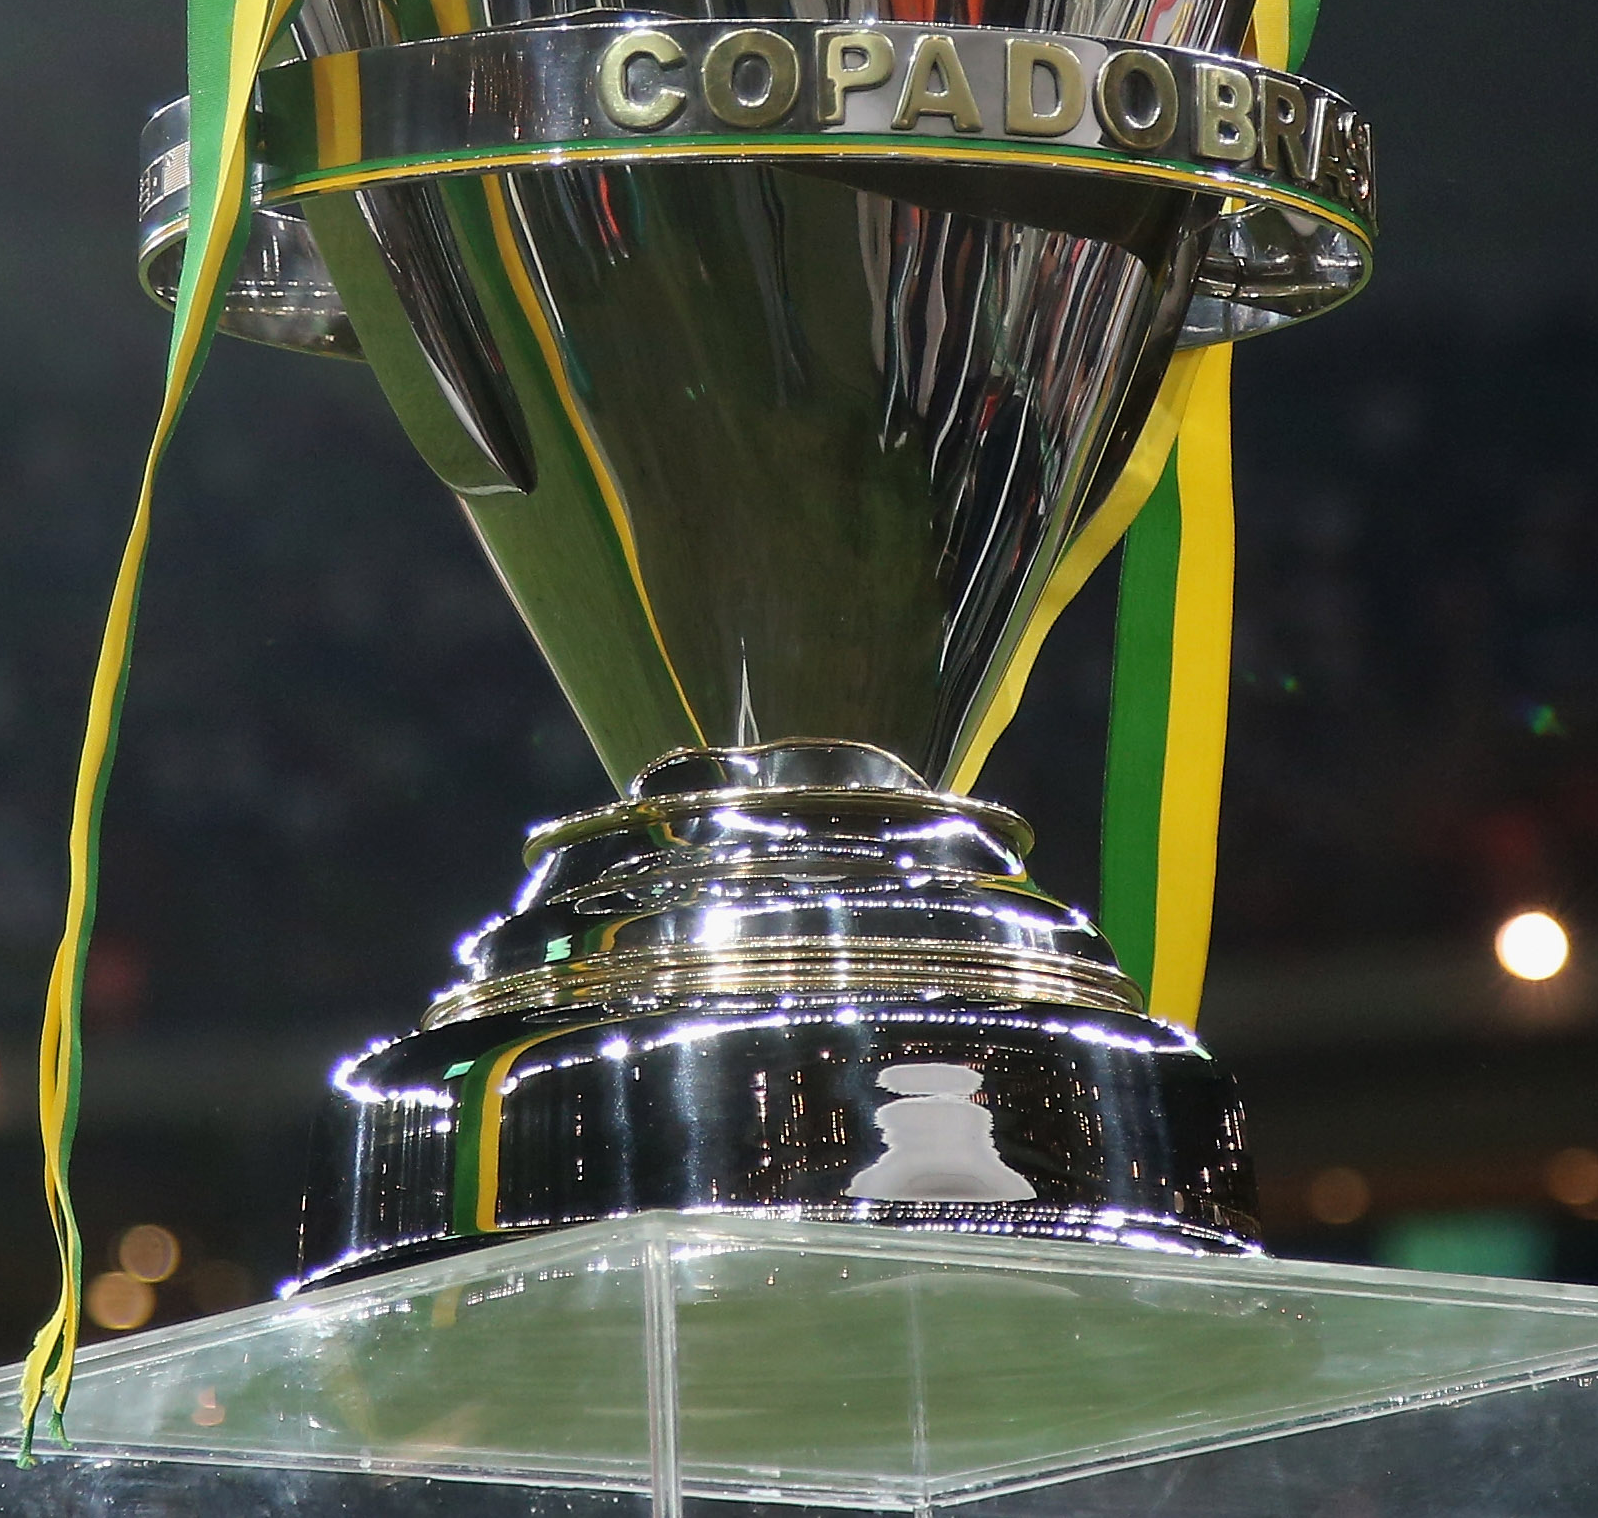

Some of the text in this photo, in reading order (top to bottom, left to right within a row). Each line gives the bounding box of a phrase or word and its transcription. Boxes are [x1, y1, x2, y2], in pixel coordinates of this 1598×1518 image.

[597, 27, 1378, 225] COPA DO BRAS
